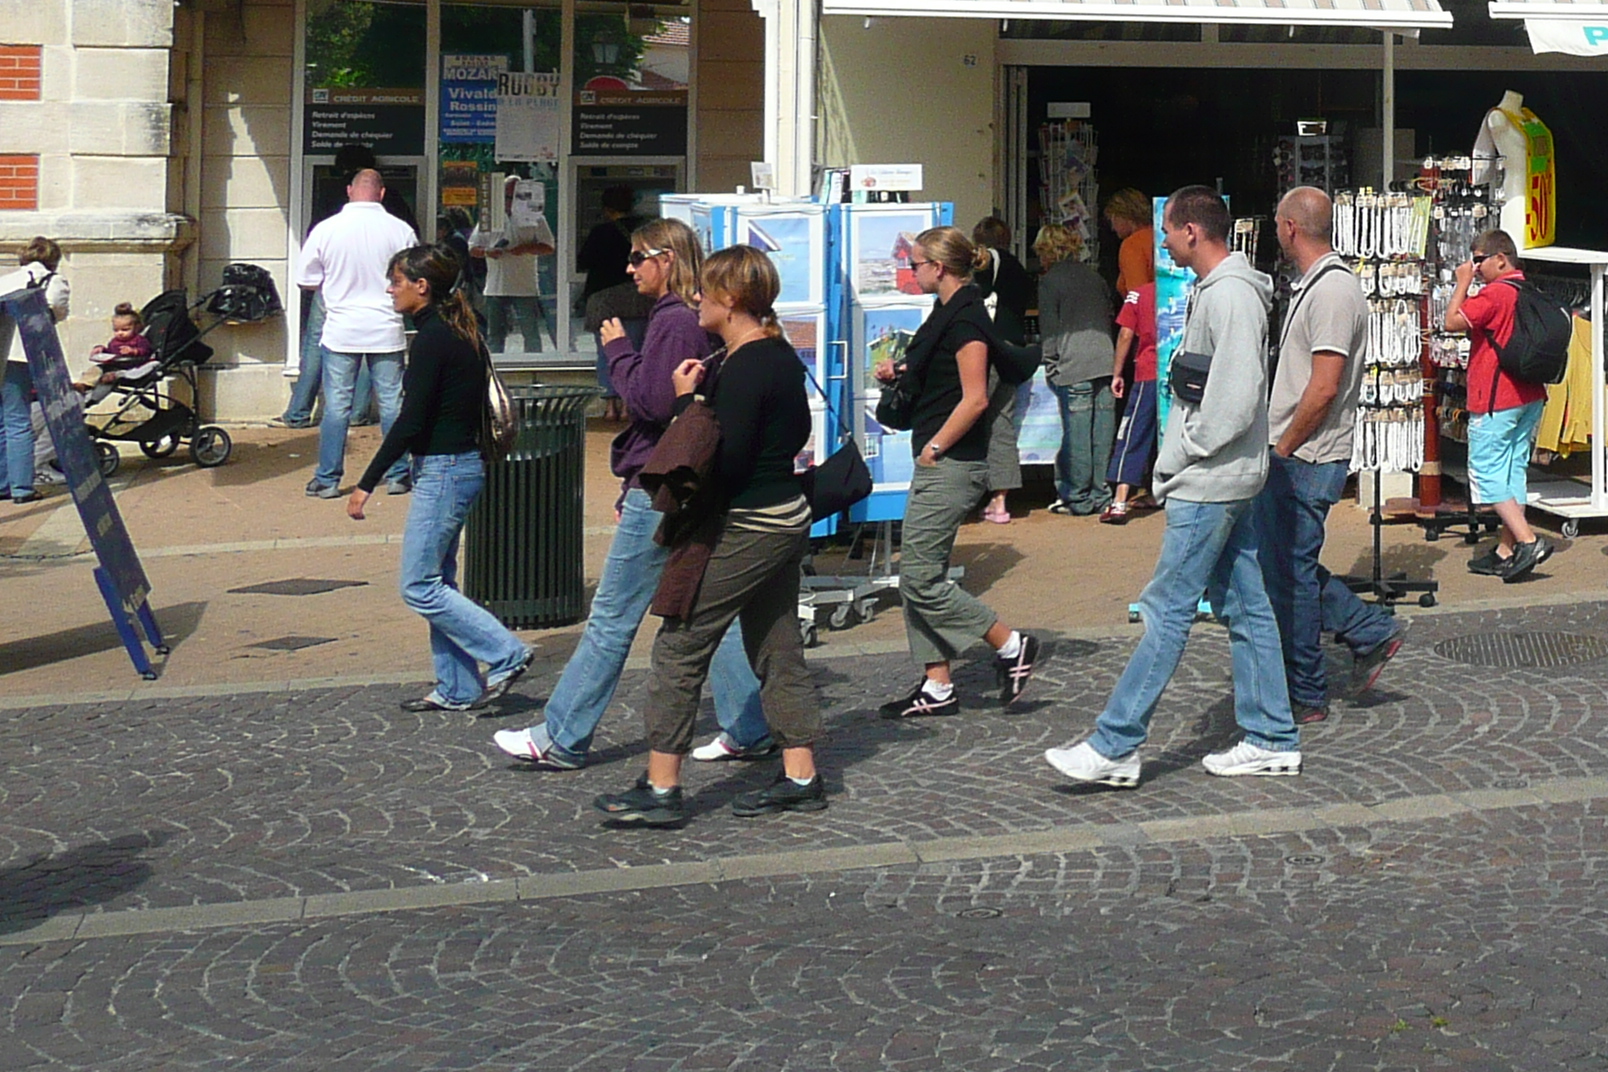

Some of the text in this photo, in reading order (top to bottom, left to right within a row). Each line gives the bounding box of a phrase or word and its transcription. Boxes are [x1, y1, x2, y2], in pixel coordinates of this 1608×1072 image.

[443, 68, 498, 80] MOZAR
[448, 88, 498, 99] Vivald
[449, 101, 497, 111] Rossin
